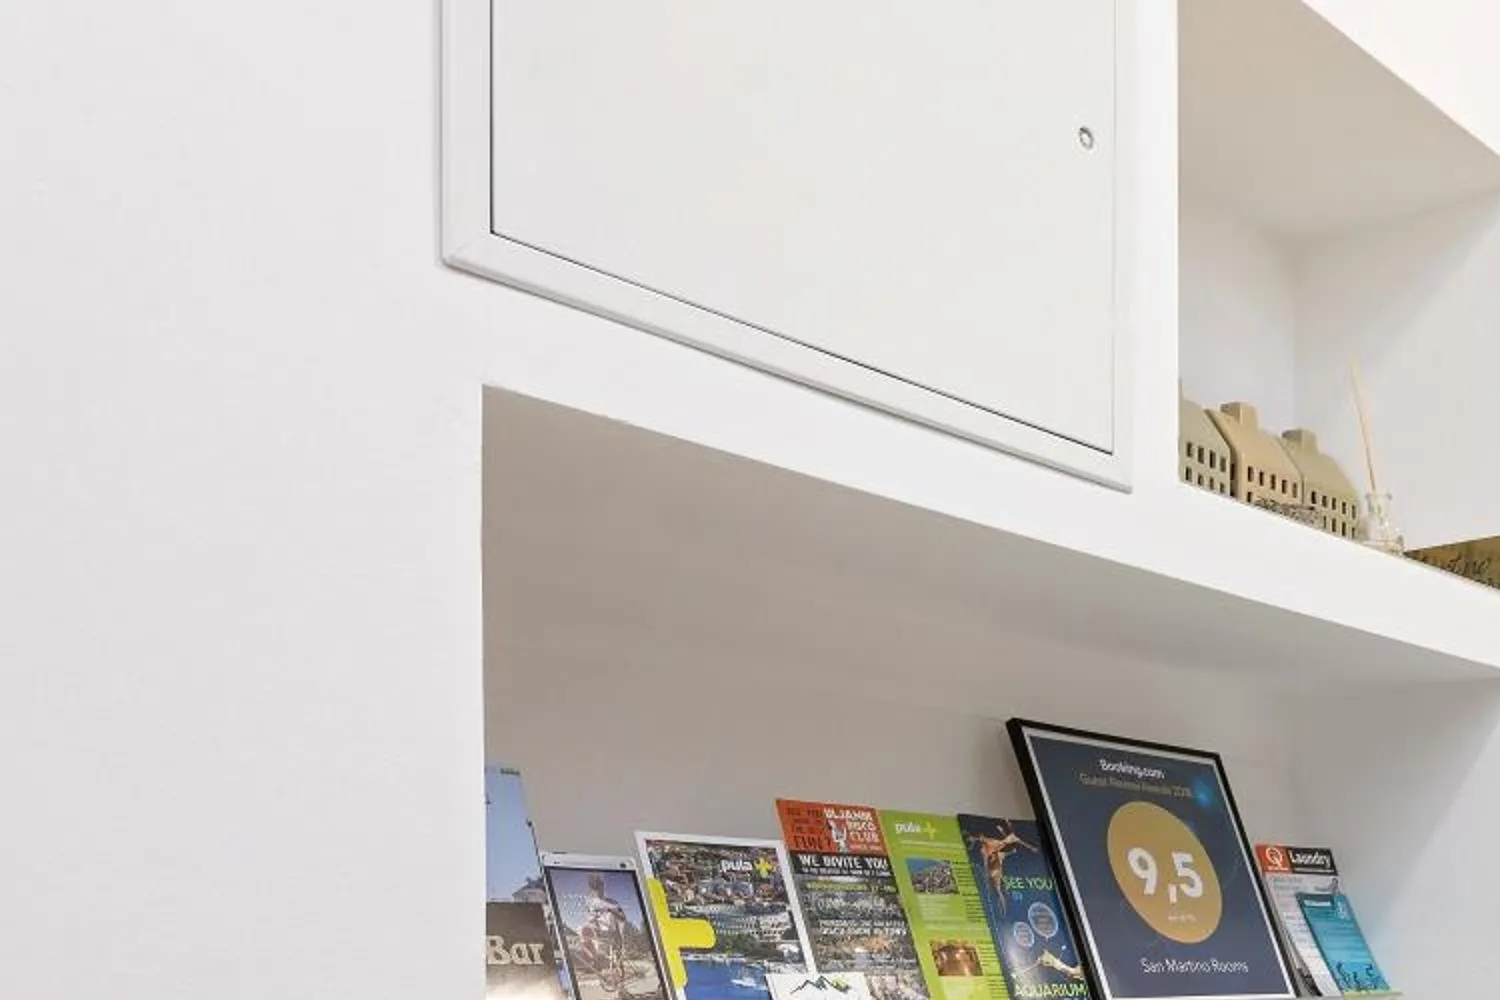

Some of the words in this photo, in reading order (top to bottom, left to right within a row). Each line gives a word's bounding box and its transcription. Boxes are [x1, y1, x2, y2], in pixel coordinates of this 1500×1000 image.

[799, 854, 821, 868] WE
[824, 855, 862, 869] INVITE
[1127, 847, 1204, 905] 9,5
[487, 935, 545, 966] Bar
[1140, 956, 1164, 974] San
